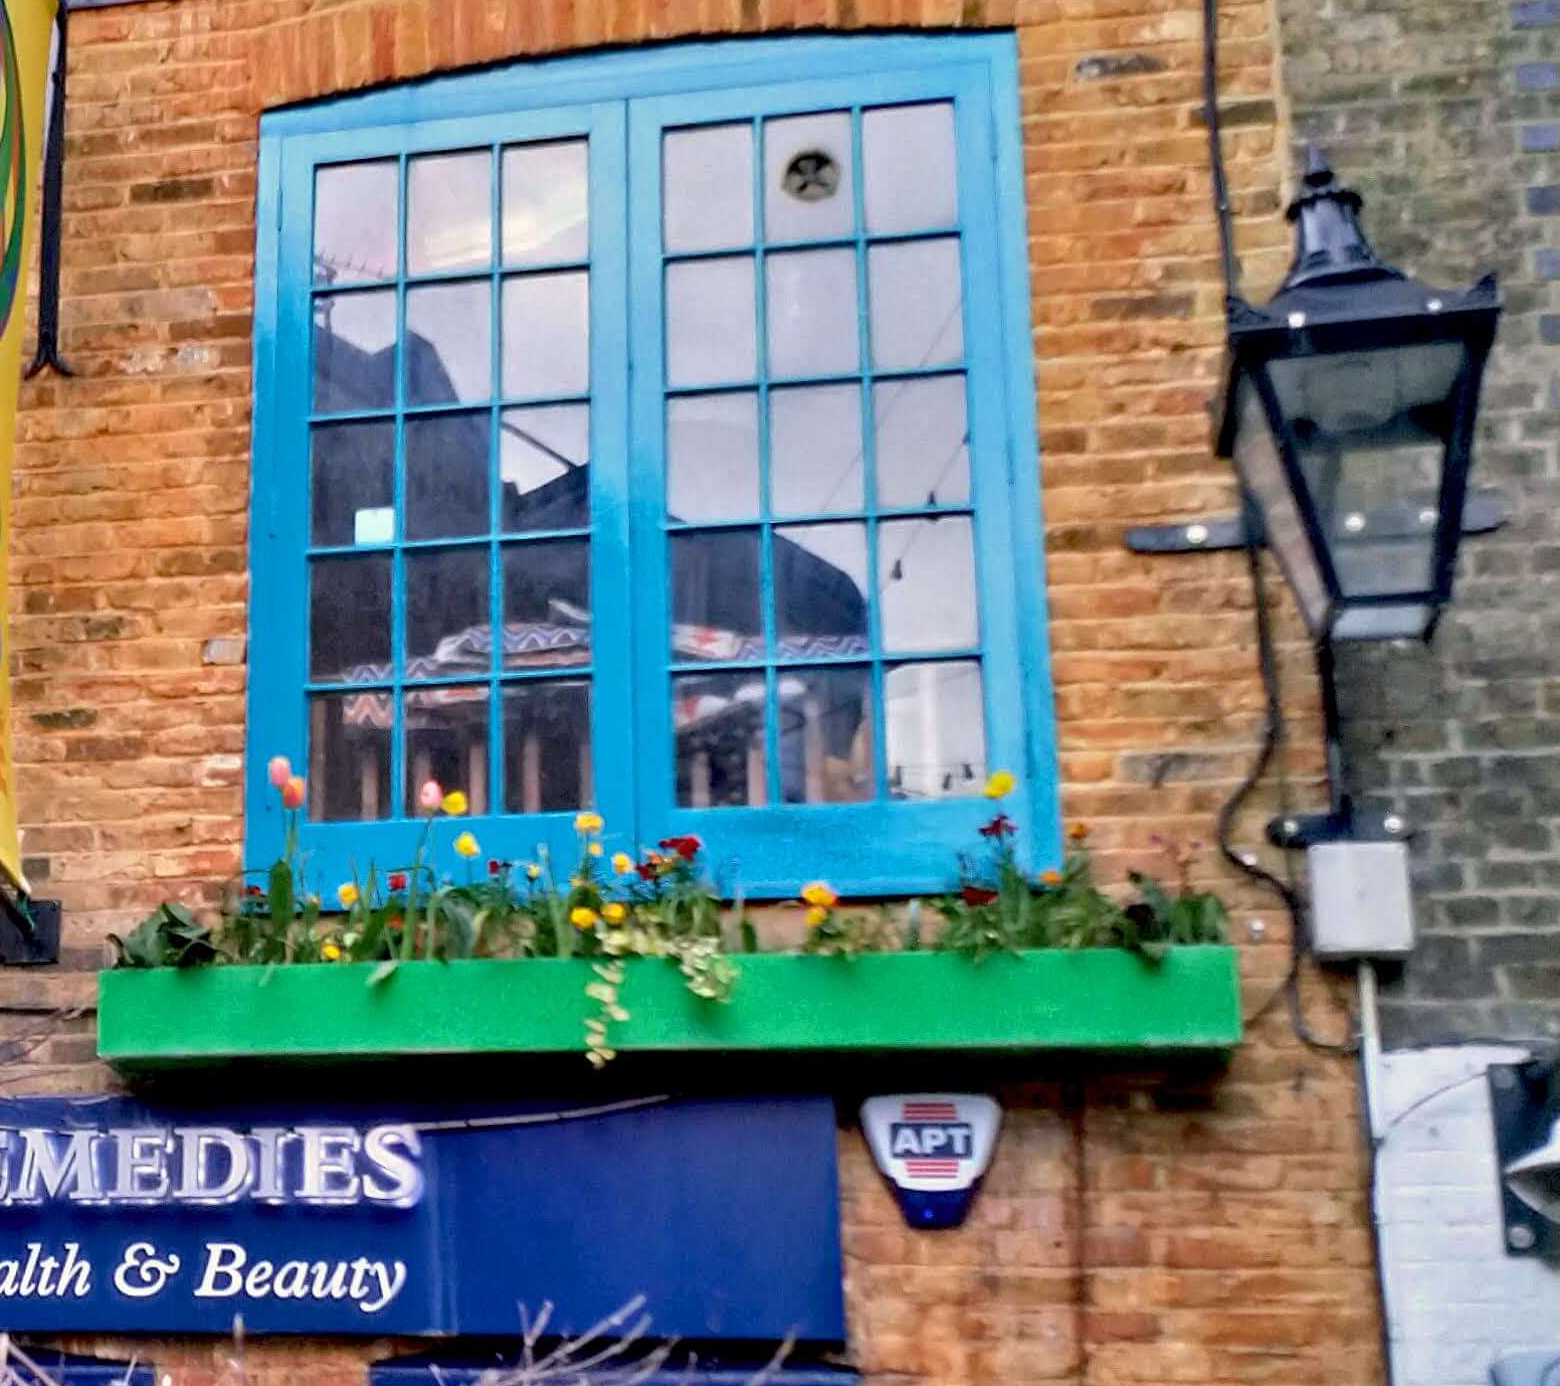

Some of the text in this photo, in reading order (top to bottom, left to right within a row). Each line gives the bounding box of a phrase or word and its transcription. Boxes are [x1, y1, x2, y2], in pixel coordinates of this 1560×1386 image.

[892, 1127, 971, 1155] APT
[114, 1242, 181, 1297] &
[193, 1242, 407, 1313] Beauty
